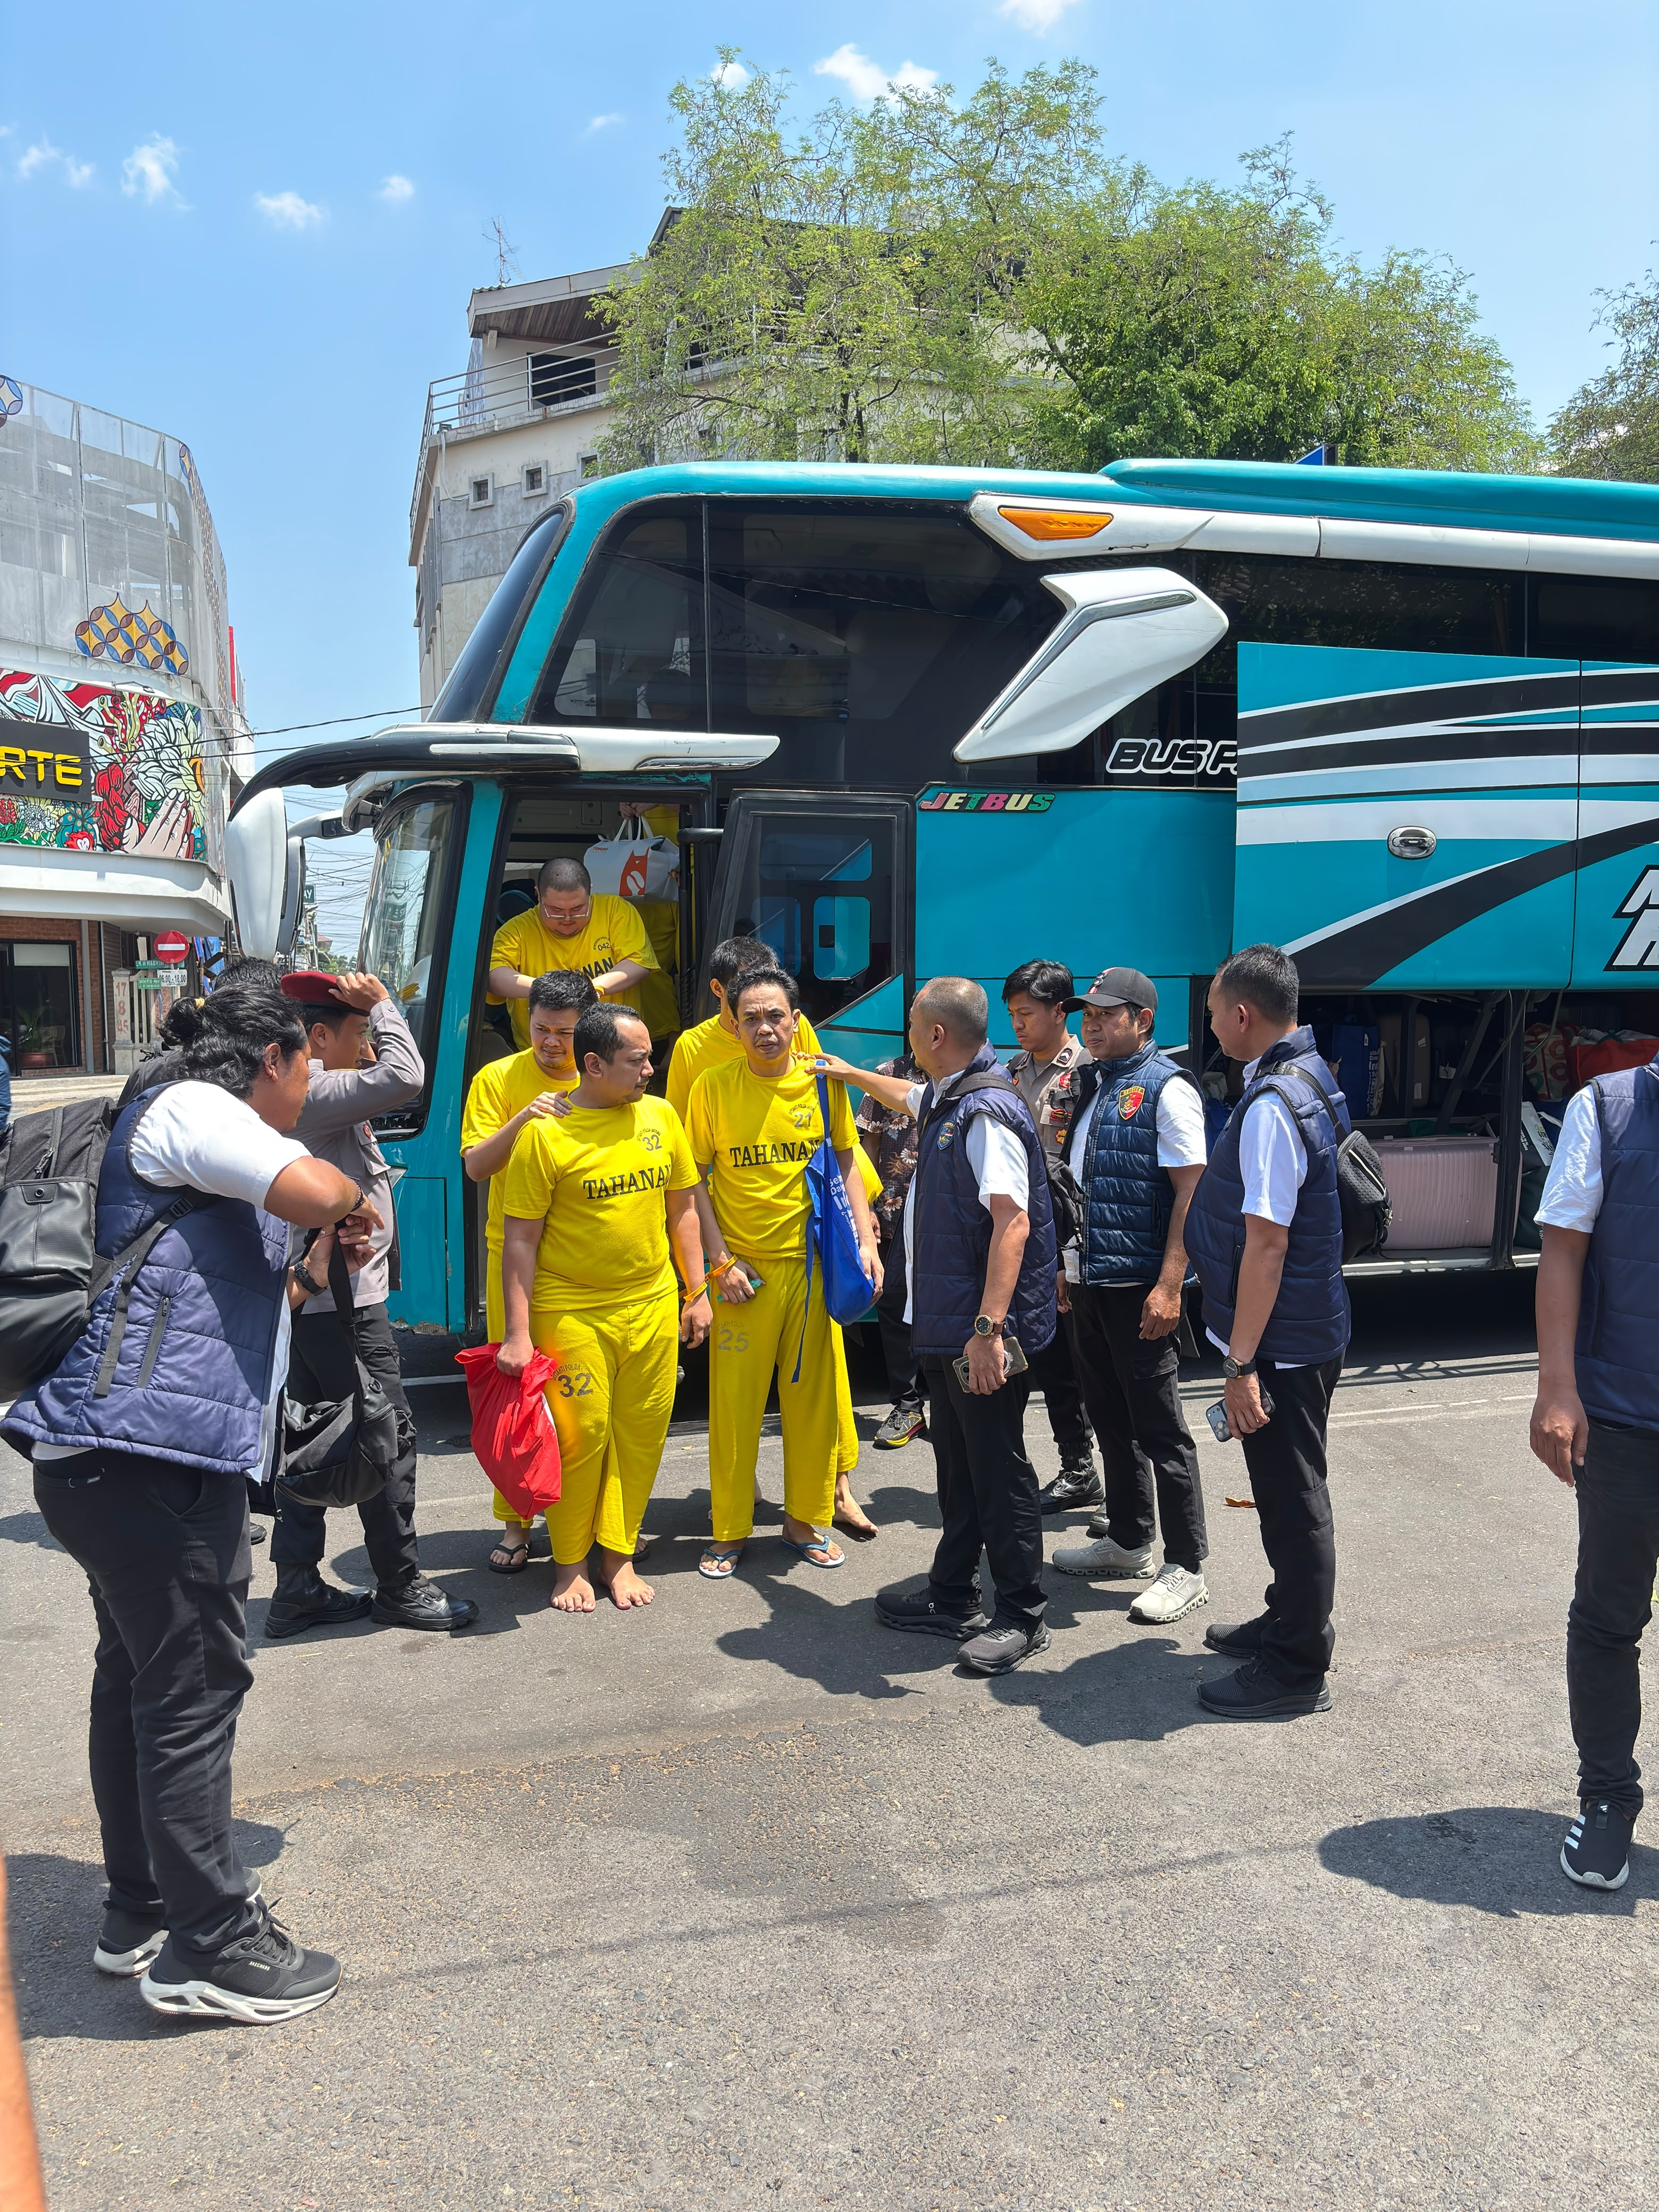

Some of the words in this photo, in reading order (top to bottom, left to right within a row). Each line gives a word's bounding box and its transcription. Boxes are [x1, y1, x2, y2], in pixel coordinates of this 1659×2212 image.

[919, 793, 1055, 812] JETBUS
[304, 889, 312, 899] AY
[598, 942, 610, 951] 042
[116, 982, 127, 996] 17
[118, 1000, 125, 1016] 8
[794, 1112, 811, 1127] 21
[642, 1134, 662, 1151] 32
[718, 1328, 749, 1352] 25
[558, 1372, 594, 1398] 32
